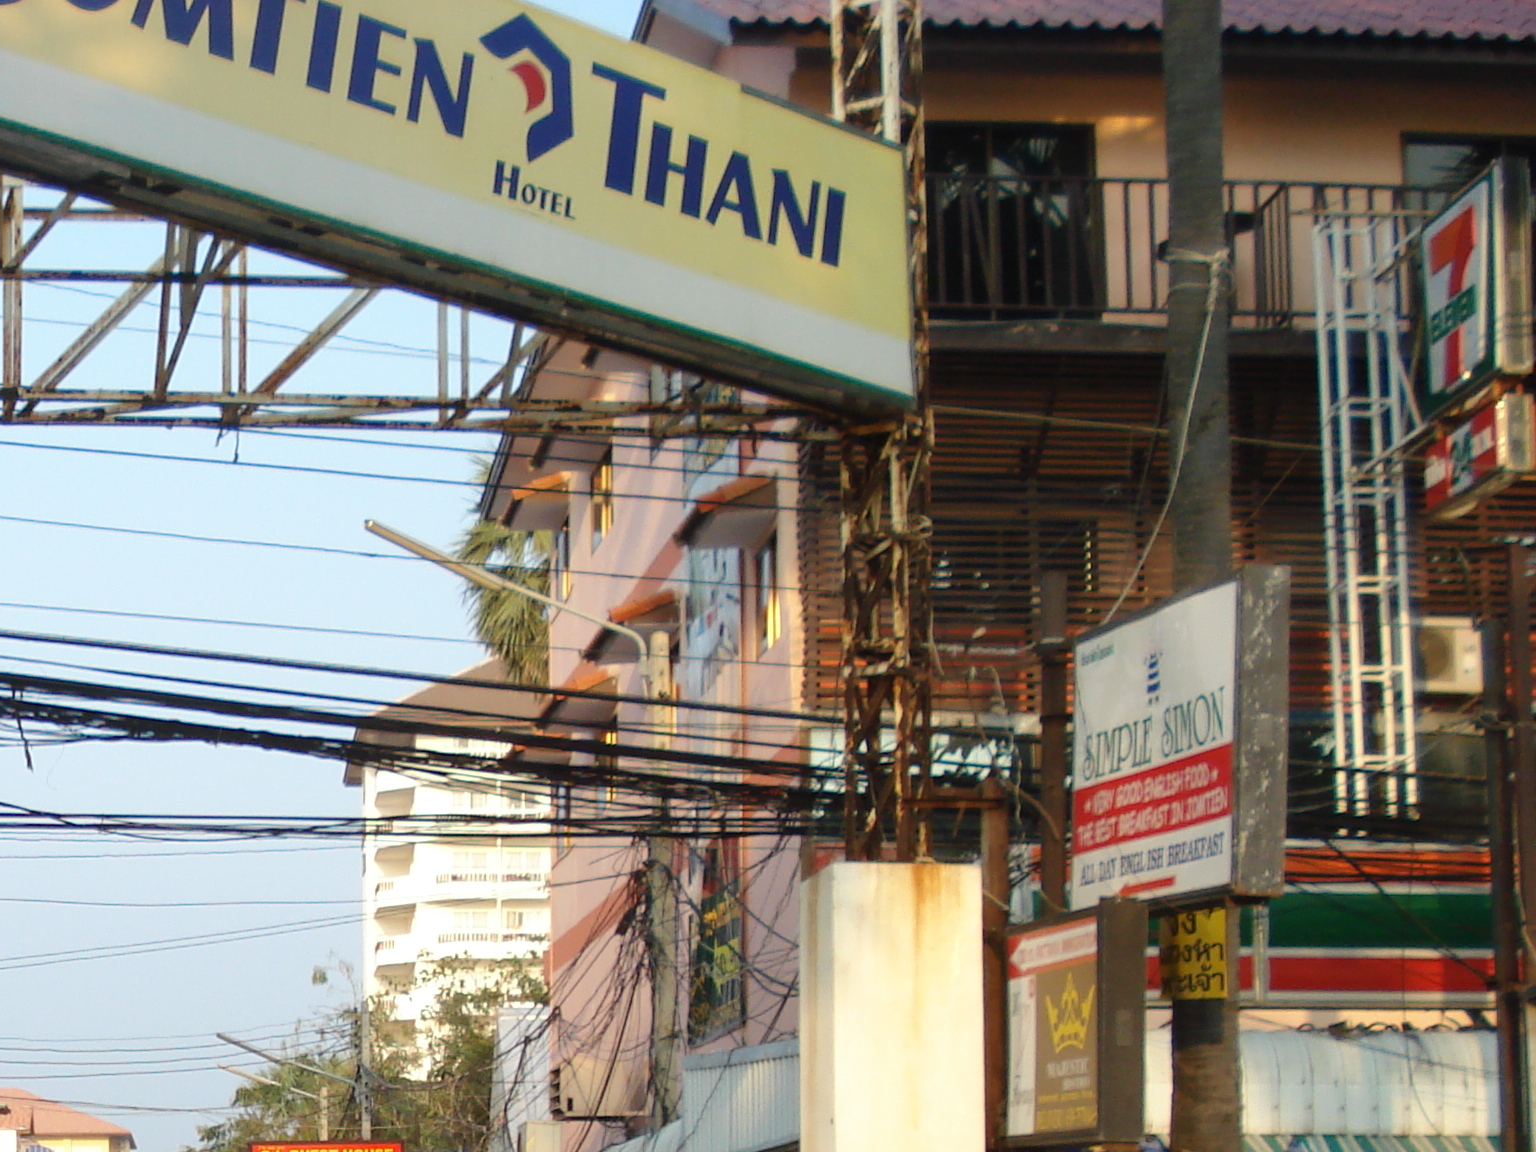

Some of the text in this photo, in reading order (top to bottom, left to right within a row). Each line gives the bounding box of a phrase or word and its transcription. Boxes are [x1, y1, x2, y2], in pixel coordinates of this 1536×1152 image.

[492, 159, 576, 220] HOTEL
[592, 61, 847, 267] THANI
[1429, 204, 1478, 387] 7
[1083, 686, 1226, 782] SIMPLE SIMON
[1116, 780, 1143, 808] GOOD
[1185, 762, 1210, 790] FOOD
[1080, 863, 1096, 887] ALL
[1098, 857, 1118, 882] DAY
[1167, 831, 1225, 866] BREAKFAST
